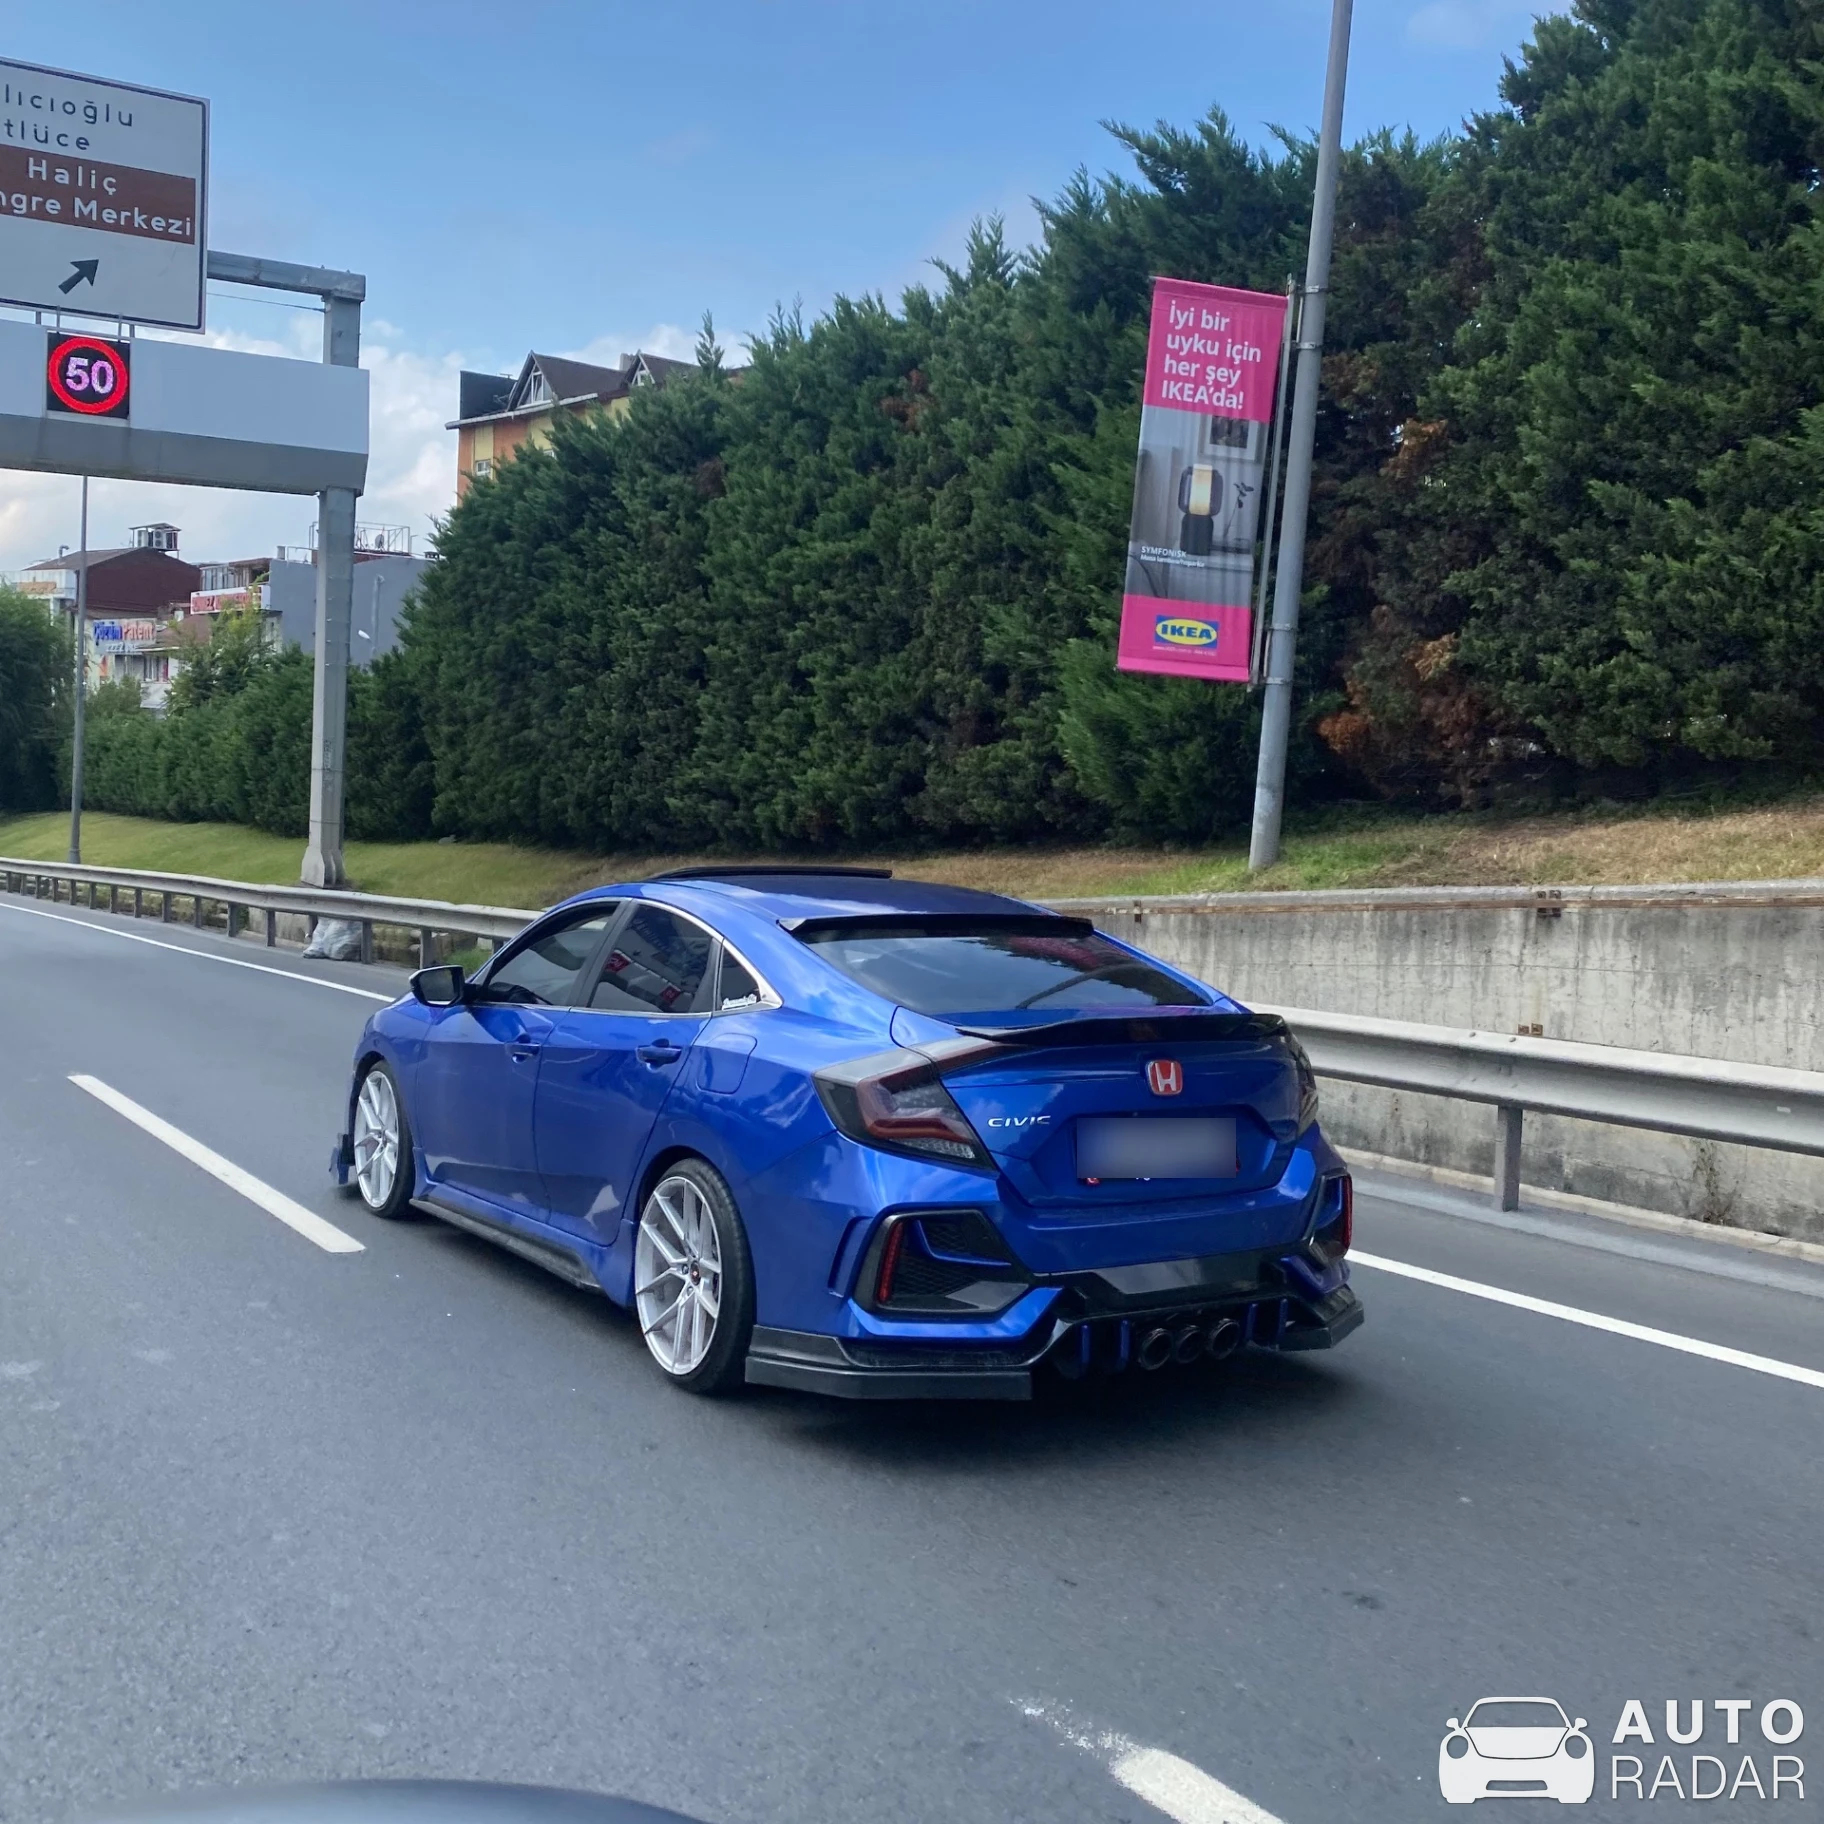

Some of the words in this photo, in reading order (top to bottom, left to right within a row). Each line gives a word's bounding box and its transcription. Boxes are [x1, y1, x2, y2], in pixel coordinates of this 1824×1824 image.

[4, 119, 90, 150] tlüce
[28, 157, 117, 196] Haliç
[74, 197, 191, 236] Merkezi
[1169, 300, 1195, 330] İyi
[1201, 309, 1230, 332] bir
[1167, 333, 1220, 356] uyku
[1226, 338, 1261, 365] için
[65, 356, 114, 394] 50
[1164, 354, 1200, 377] her
[1205, 365, 1241, 388] şey
[1162, 380, 1244, 409] IKEA'da!
[1141, 546, 1187, 558] SYMFONISK
[1161, 624, 1212, 640] IKEA
[987, 1115, 1051, 1128] CIVIC
